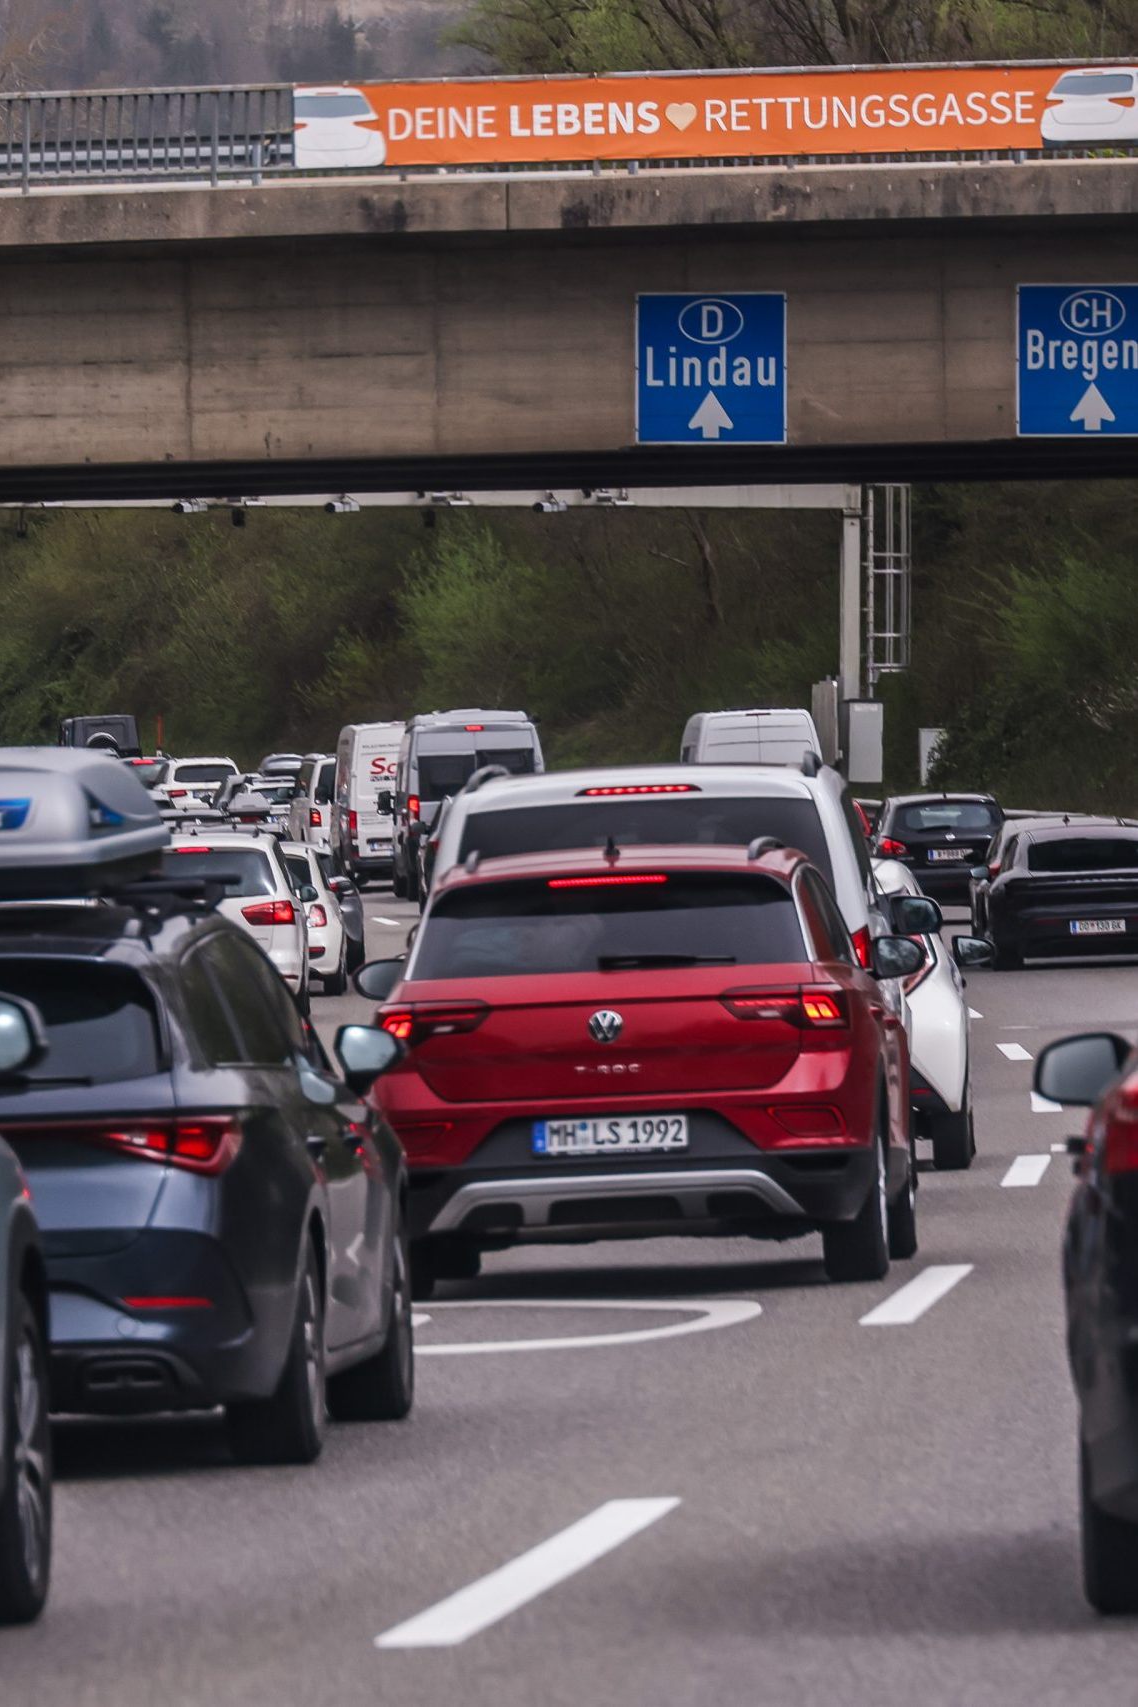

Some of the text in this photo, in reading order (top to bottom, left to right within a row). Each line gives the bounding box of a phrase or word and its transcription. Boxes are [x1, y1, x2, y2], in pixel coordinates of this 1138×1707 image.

[388, 90, 1037, 141] DEINE LEBENS RETTUNGSGASSE
[701, 305, 724, 338] D
[1070, 298, 1112, 329] CH
[646, 345, 776, 387] Lindau
[547, 1118, 683, 1147] MH LS 1992
